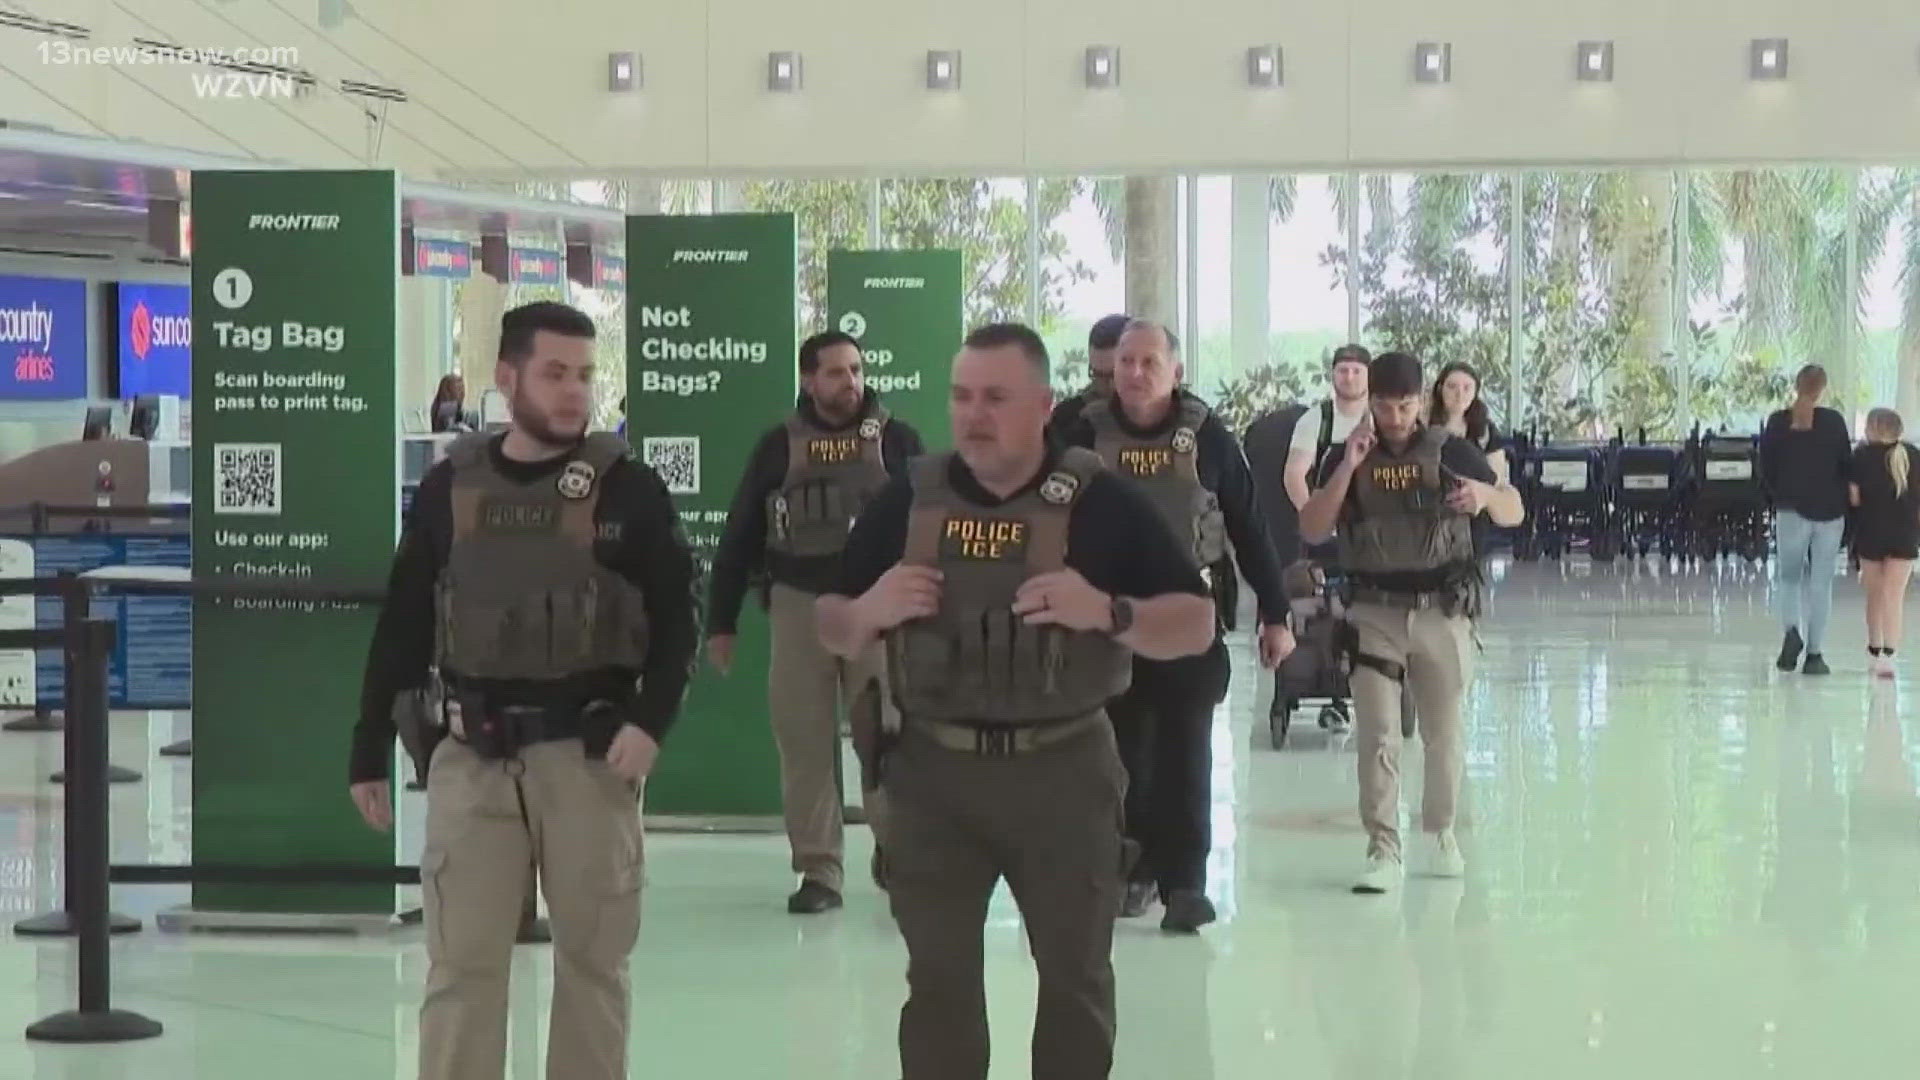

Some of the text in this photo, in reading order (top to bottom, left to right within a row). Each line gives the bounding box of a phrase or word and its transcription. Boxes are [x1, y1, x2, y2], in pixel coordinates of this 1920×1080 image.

[249, 214, 339, 230] FRONTIER
[673, 249, 749, 262] FRONTIER
[641, 305, 691, 328] Not
[213, 321, 345, 352] Tag Bag
[641, 337, 767, 363] Checking
[863, 349, 893, 367] op
[214, 370, 346, 390] Scan boarding
[642, 370, 722, 396] Bags?
[214, 394, 368, 412] pass to print tag.
[811, 438, 858, 455] POLICE
[1121, 449, 1171, 465] POLICE
[1133, 463, 1158, 475] ICE
[1373, 464, 1420, 481] POLICE
[1385, 479, 1408, 491] ICE
[947, 519, 1025, 542] POLICE
[214, 530, 329, 550] Use our app:
[962, 541, 1001, 559] ICE
